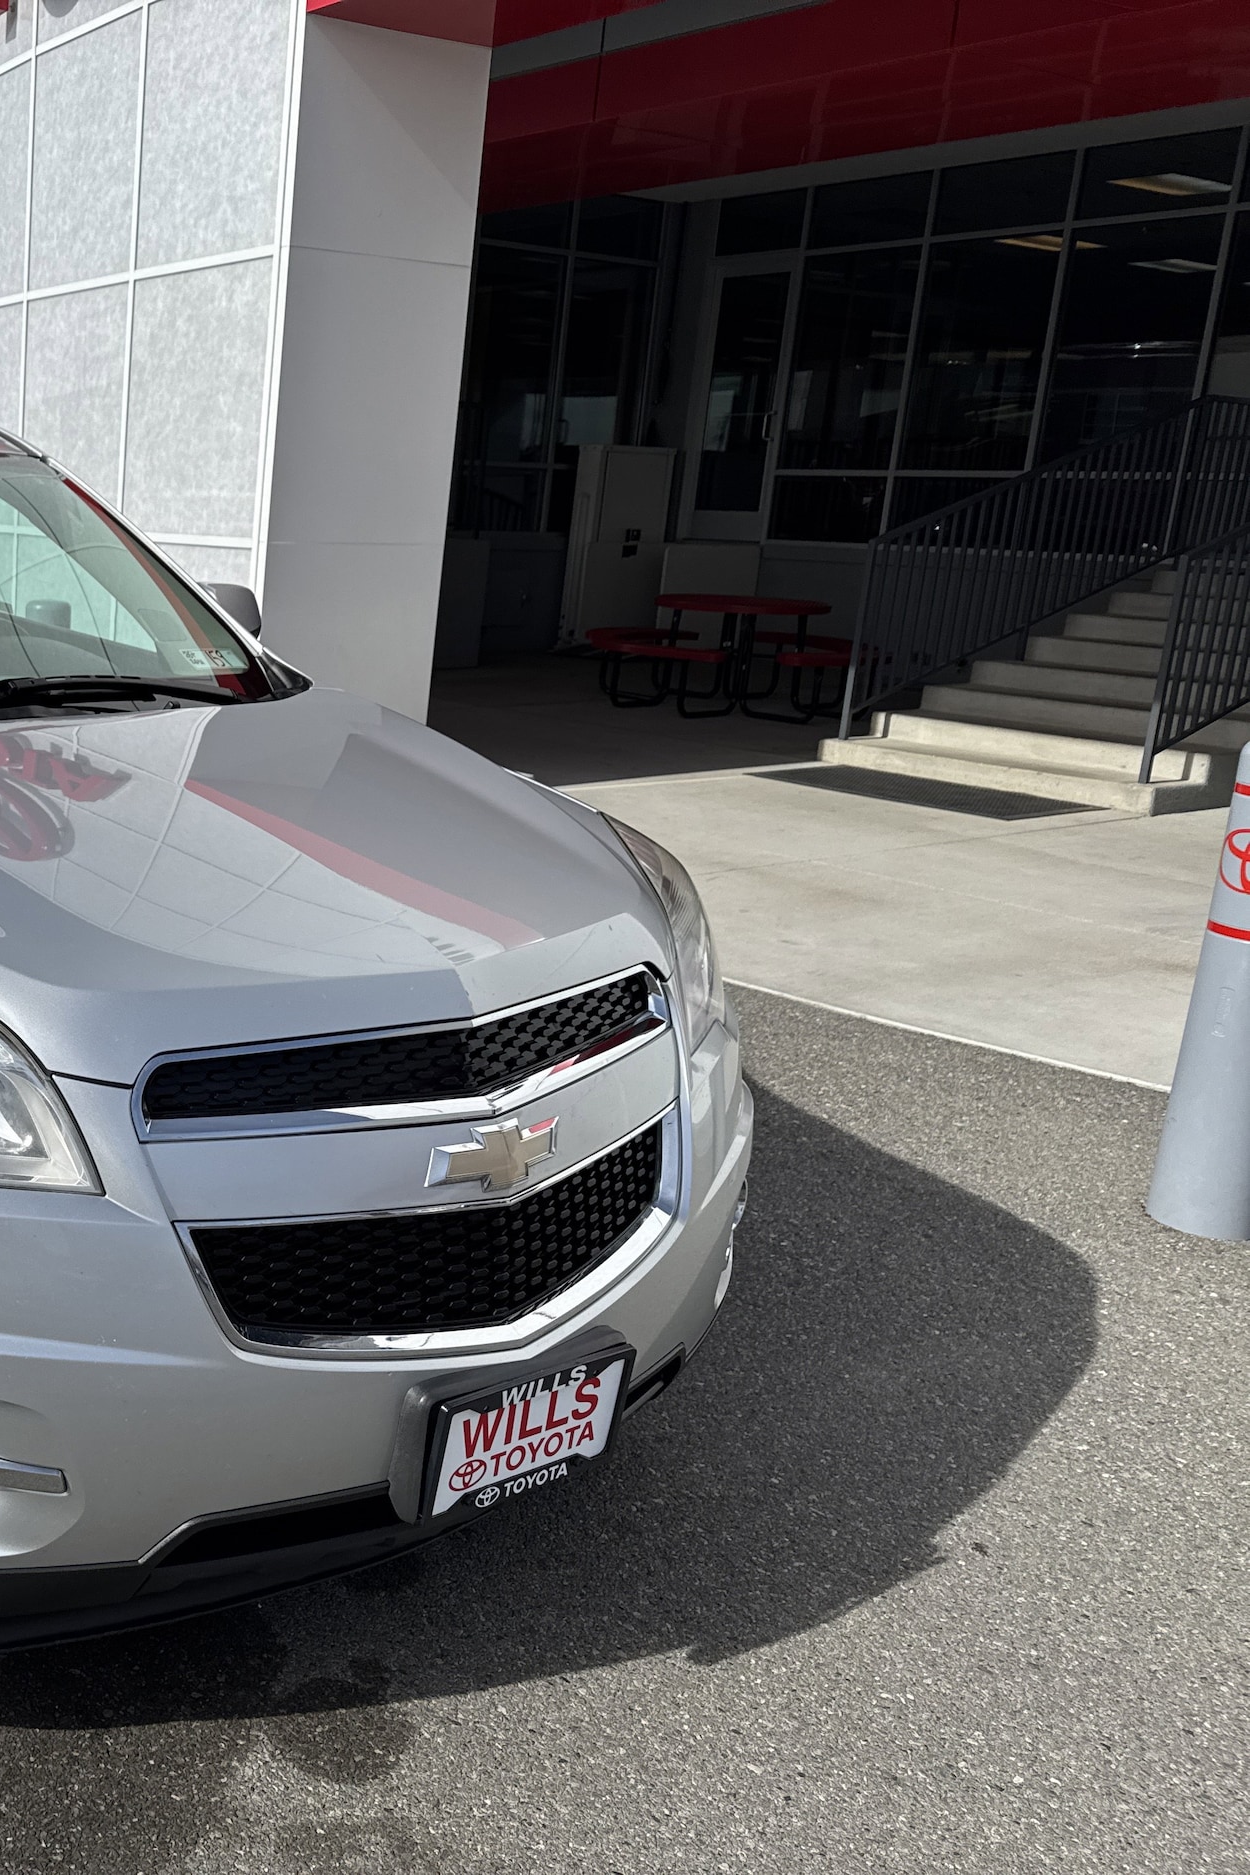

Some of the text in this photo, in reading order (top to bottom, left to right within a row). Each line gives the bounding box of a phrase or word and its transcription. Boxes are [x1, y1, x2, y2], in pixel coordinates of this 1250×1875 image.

[501, 1364, 588, 1409] WILLS
[462, 1376, 602, 1459] WILLS
[490, 1420, 595, 1477] TOYOTA
[503, 1462, 568, 1498] TOYOTA
